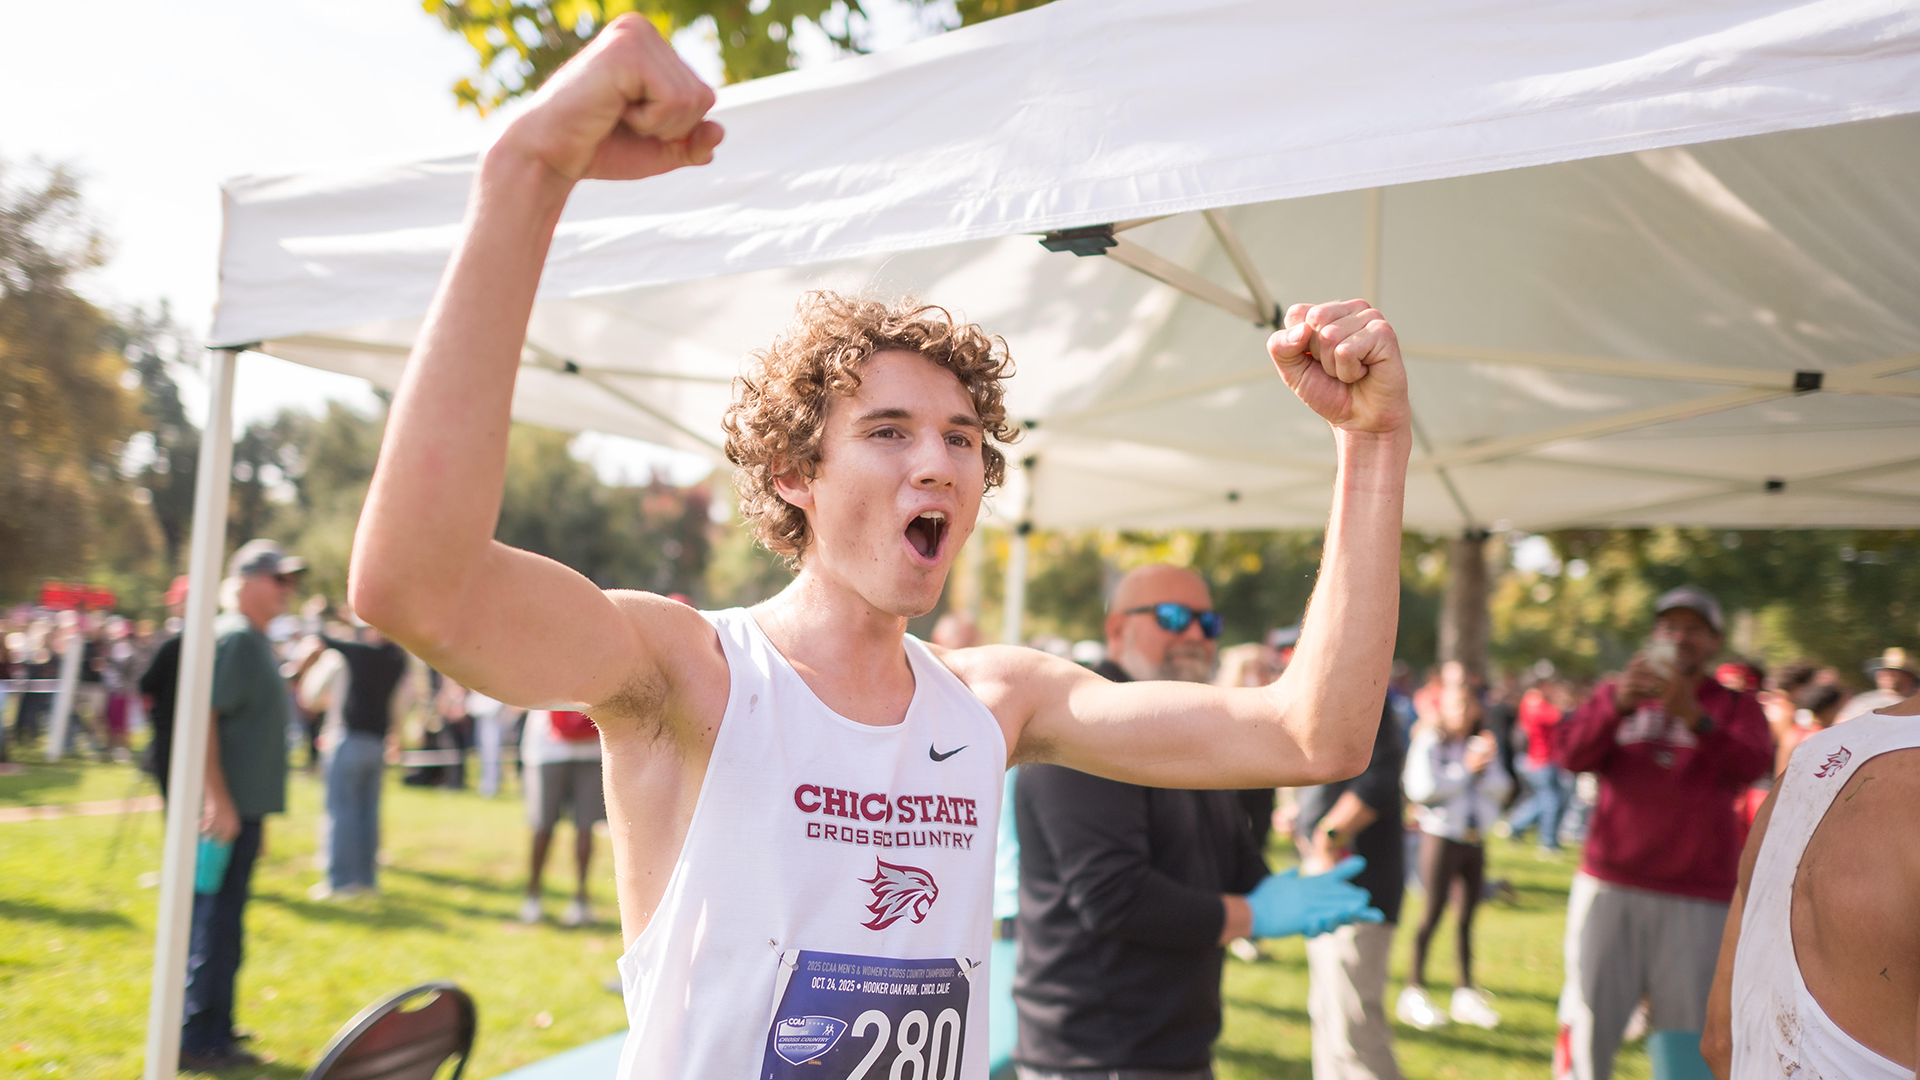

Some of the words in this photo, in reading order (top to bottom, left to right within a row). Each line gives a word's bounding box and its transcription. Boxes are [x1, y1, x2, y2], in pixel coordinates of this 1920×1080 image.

[896, 795, 978, 827] STATE
[807, 822, 883, 846] CROSS
[882, 830, 973, 849] COUNTRY
[807, 960, 821, 971] 2025
[821, 961, 837, 973] CCAA
[837, 963, 856, 974] MEN'S
[856, 966, 861, 975] &
[862, 966, 888, 977] WOMEN'S
[888, 967, 906, 979] CROSS
[906, 968, 926, 979] COUNTRY
[925, 968, 955, 979] CHAMPIONSHIPS
[811, 976, 825, 990] OCT.
[838, 979, 856, 992] 2025
[862, 981, 889, 994] HOOKER
[889, 983, 903, 995] OAK
[788, 1017, 805, 1026] CCAA
[845, 1007, 962, 1080] 280
